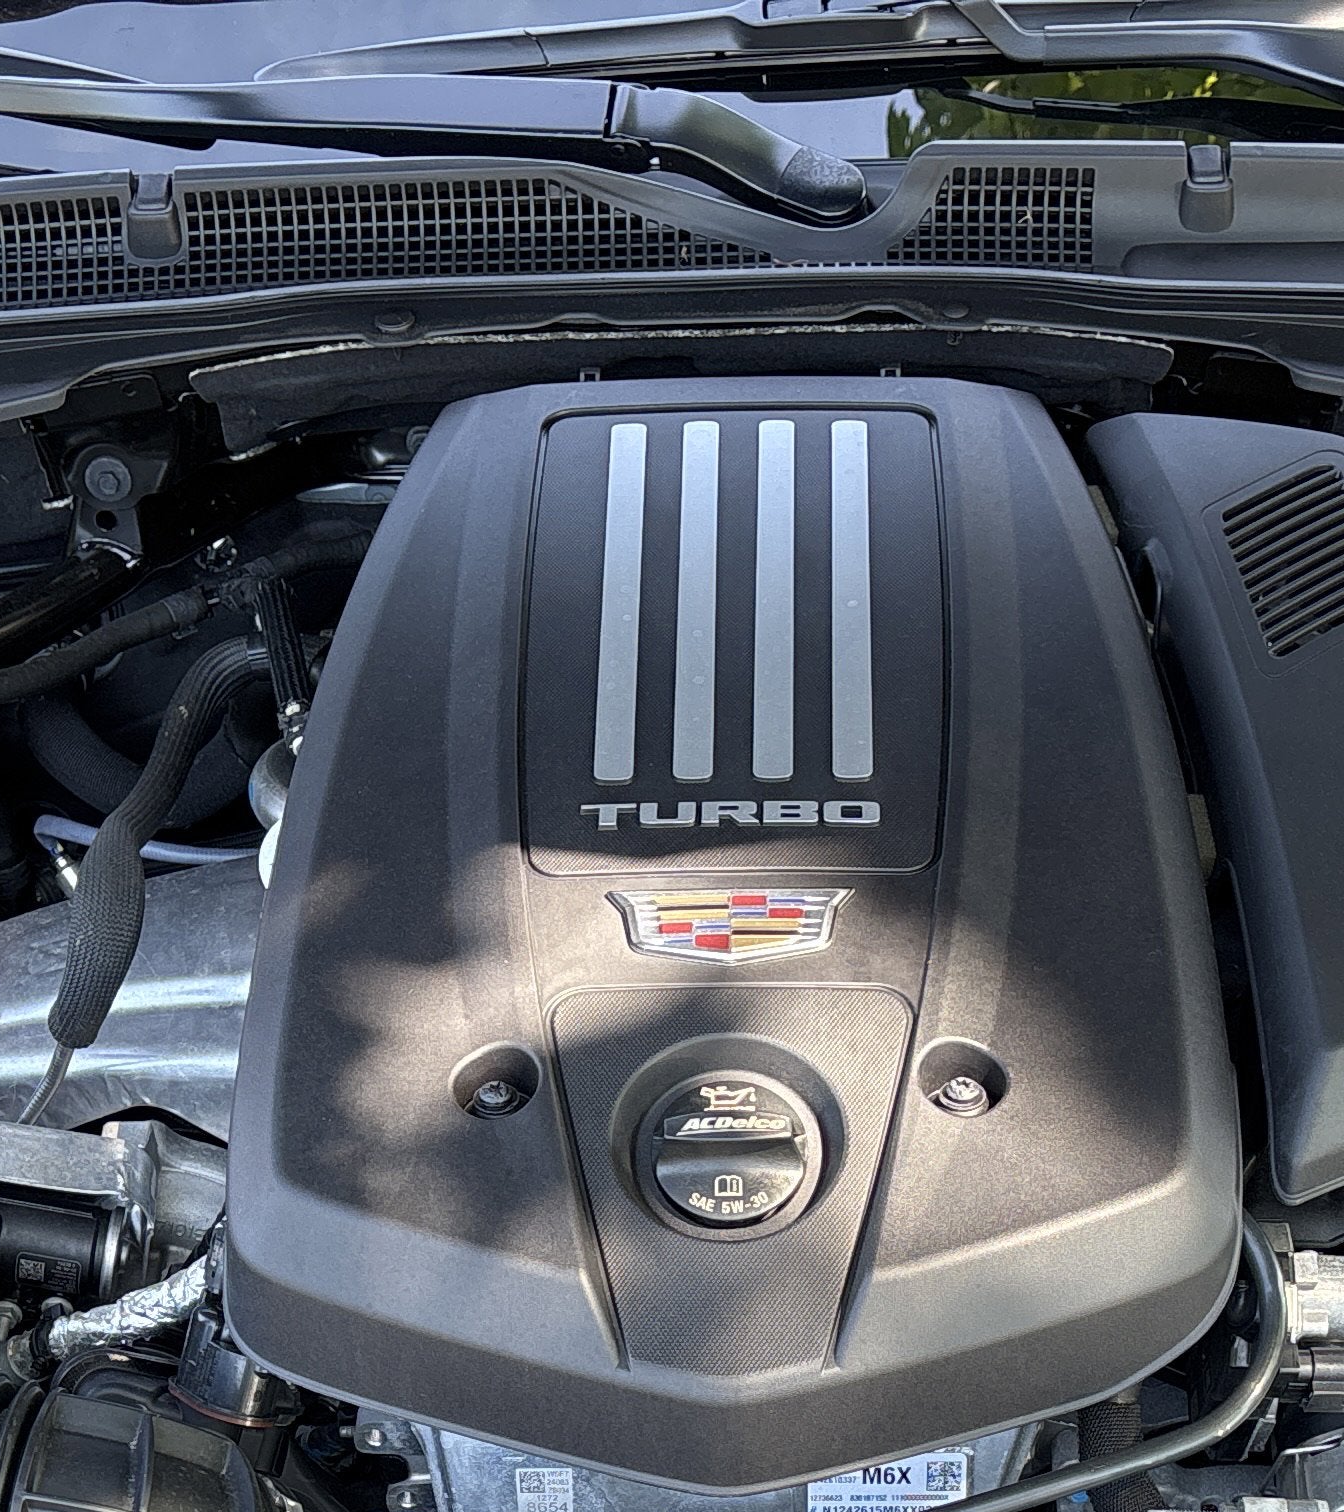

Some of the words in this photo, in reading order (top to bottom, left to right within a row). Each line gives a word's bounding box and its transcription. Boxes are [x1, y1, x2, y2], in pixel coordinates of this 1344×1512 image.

[581, 800, 881, 831] TURBO
[679, 1115, 787, 1132] ACDelco
[688, 1192, 714, 1213] SAE
[721, 1191, 769, 1214] 5W-30
[862, 1466, 912, 1485] M6X
[527, 1501, 569, 1512] 8654
